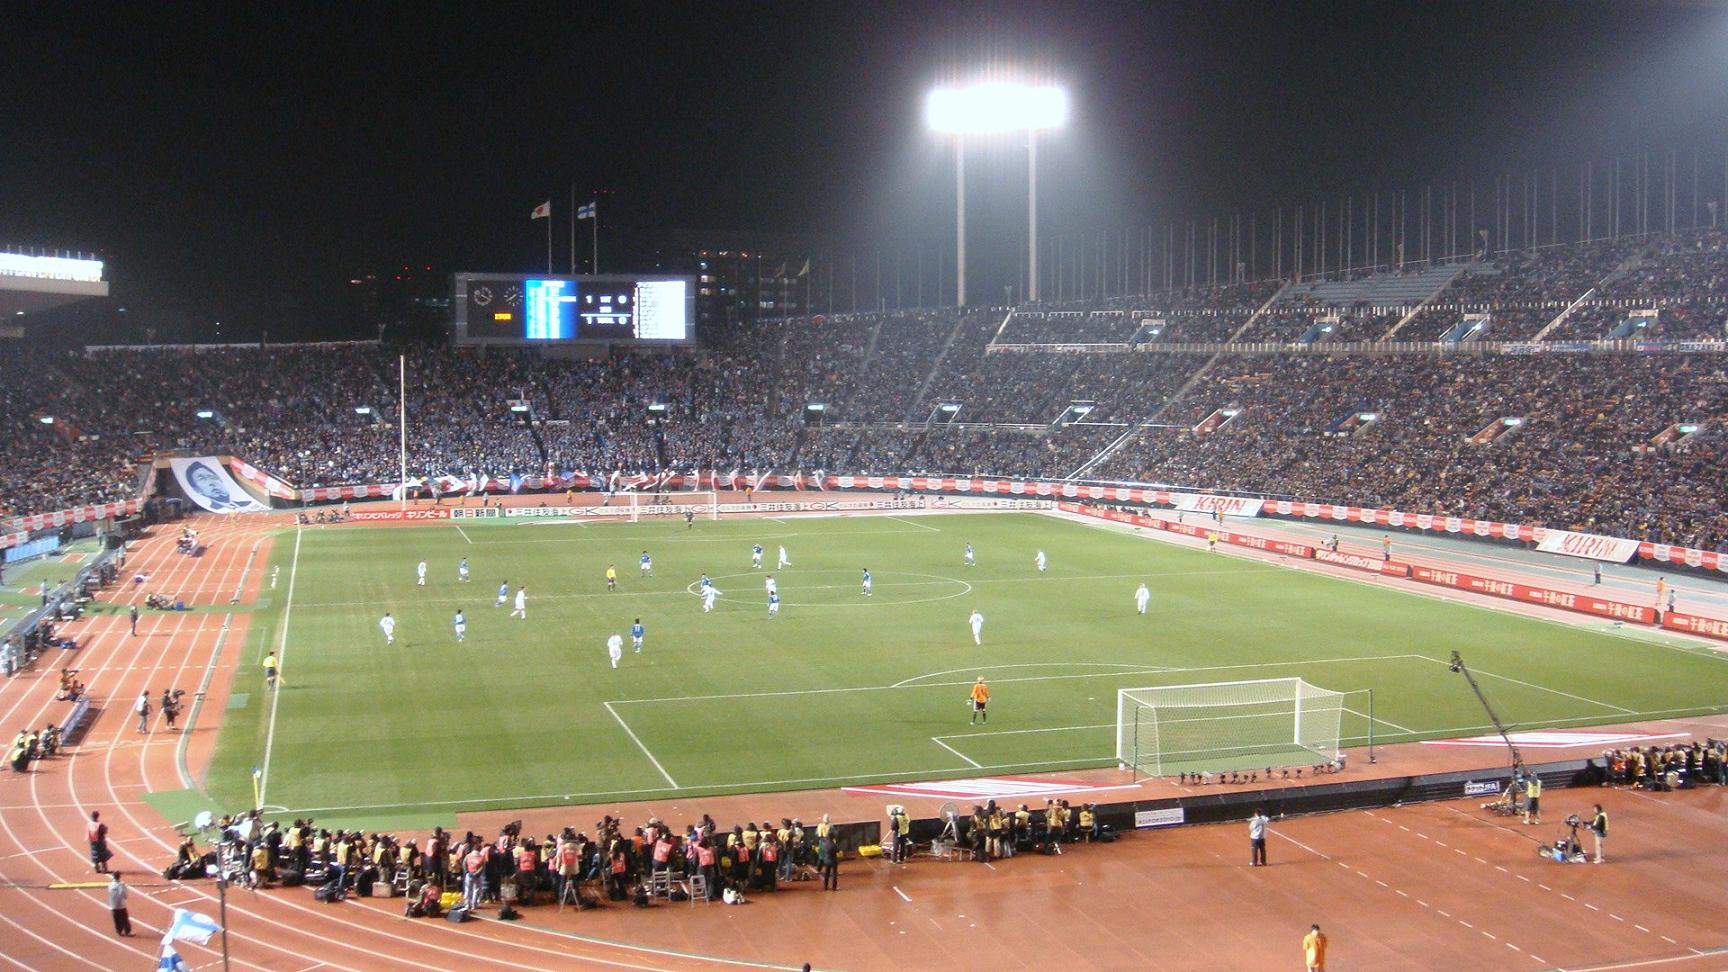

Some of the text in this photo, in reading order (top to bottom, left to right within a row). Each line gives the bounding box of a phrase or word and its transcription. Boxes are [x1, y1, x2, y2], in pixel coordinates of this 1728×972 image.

[569, 507, 600, 516] GK
[1193, 496, 1246, 512] KIRIN
[1563, 534, 1617, 557] KIRIN
